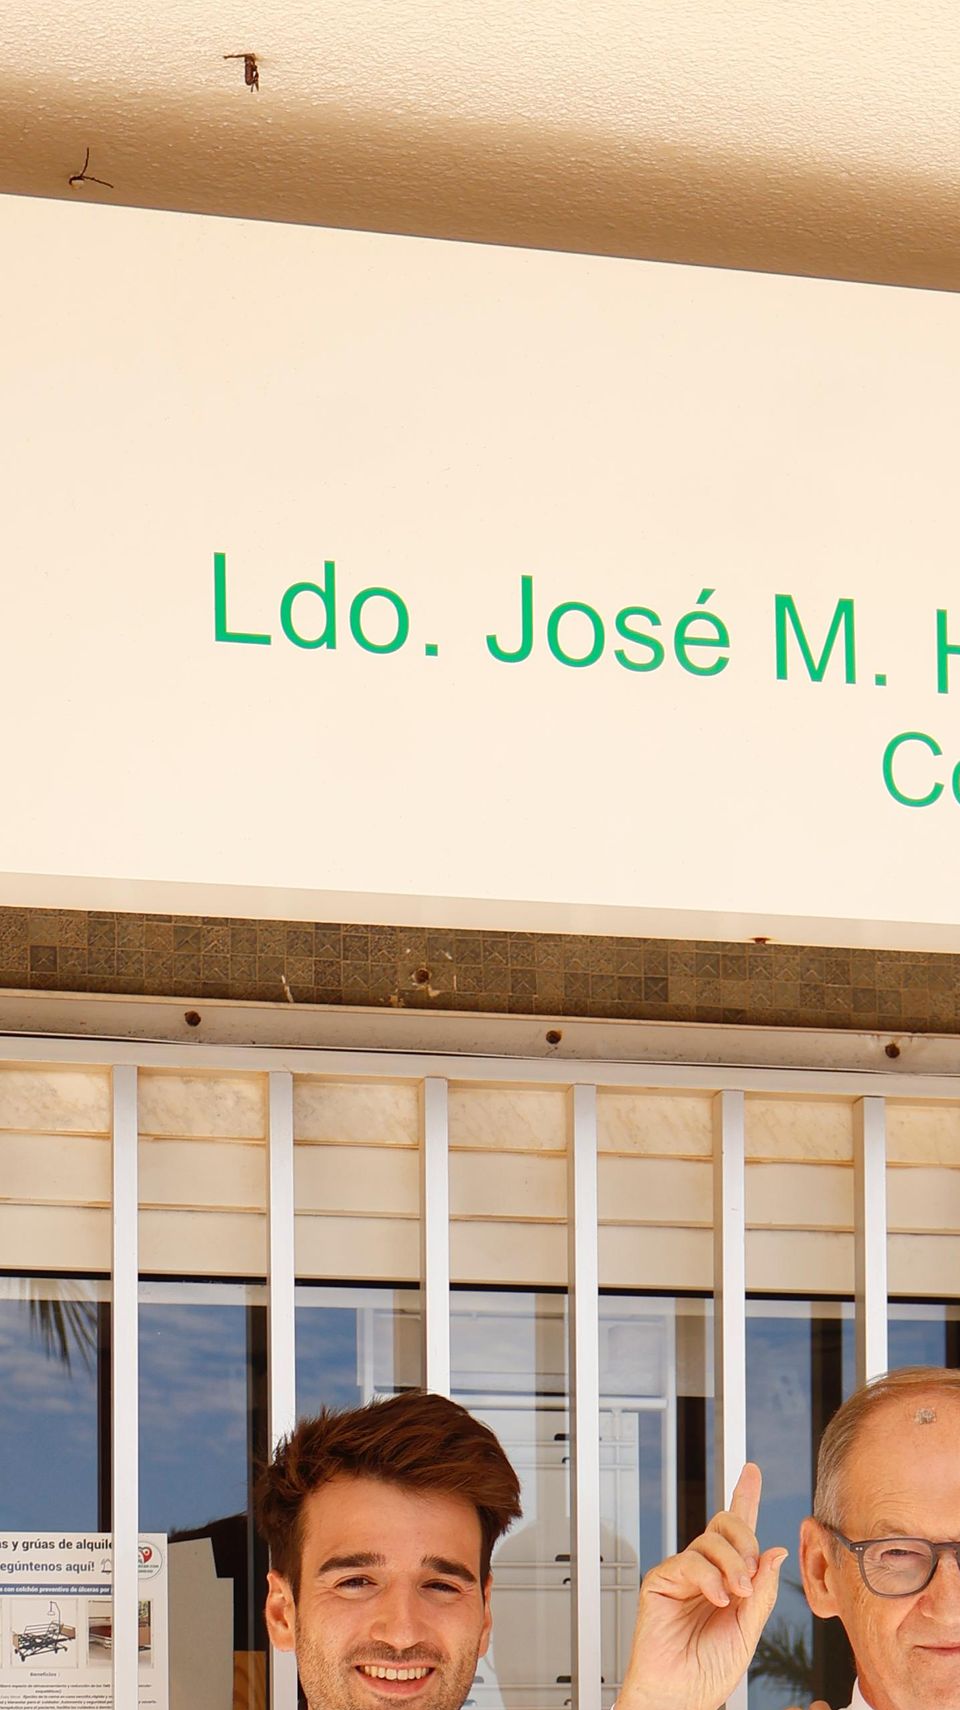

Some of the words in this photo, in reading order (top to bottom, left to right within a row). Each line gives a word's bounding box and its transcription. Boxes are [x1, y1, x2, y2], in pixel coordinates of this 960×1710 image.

[213, 552, 438, 656] Ldo.
[486, 576, 731, 677] José
[775, 594, 887, 687] M.
[0, 1541, 8, 1549] s
[11, 1541, 19, 1552] y
[22, 1538, 55, 1552] grúas
[58, 1538, 73, 1549] de
[66, 1561, 94, 1574] aquí!
